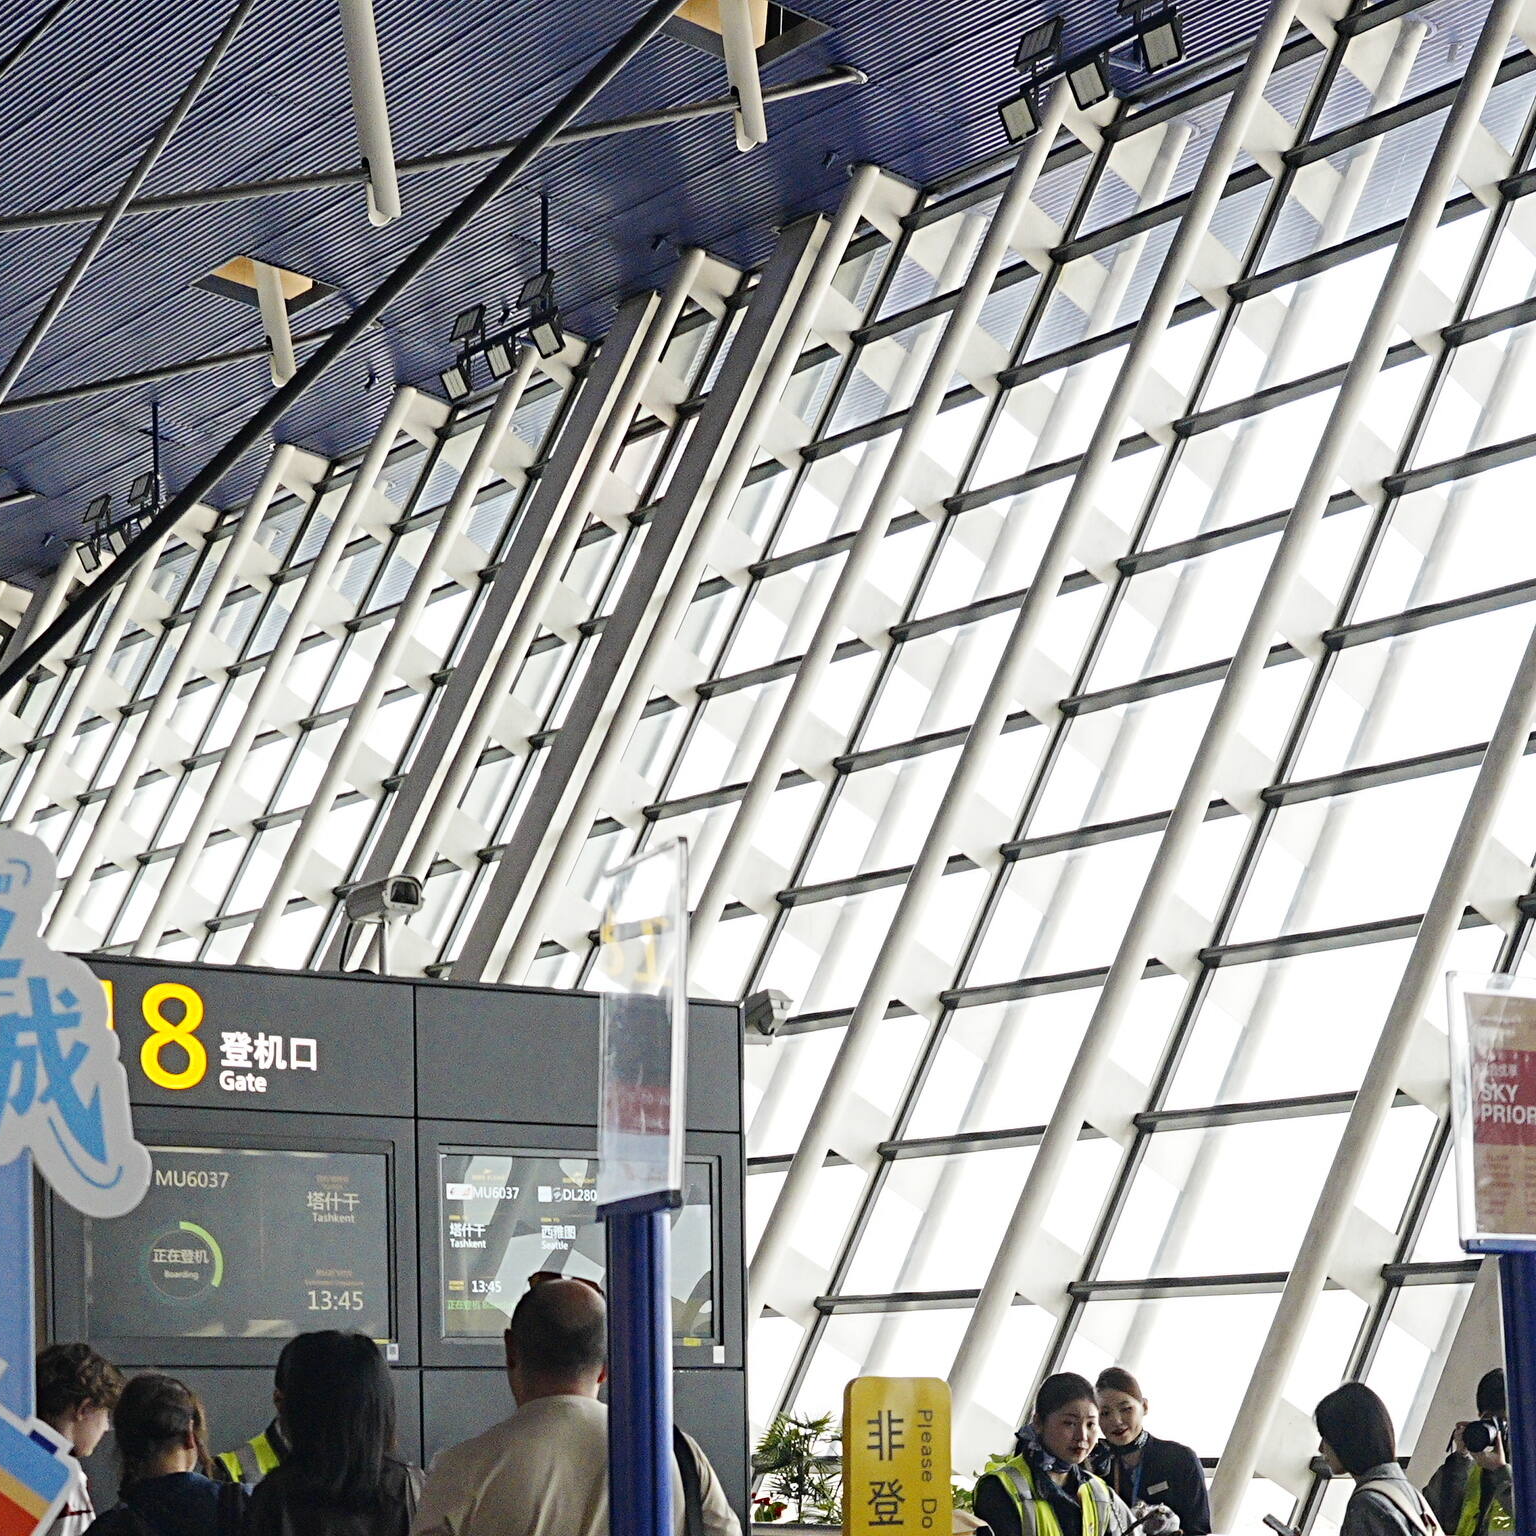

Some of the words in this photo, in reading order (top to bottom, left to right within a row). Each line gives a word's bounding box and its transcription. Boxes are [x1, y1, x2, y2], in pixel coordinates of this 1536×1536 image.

[219, 1031, 318, 1072] 登机口
[219, 1069, 268, 1093] Gate
[1481, 1083, 1520, 1104] SKY
[154, 1169, 231, 1189] MU6037
[306, 1191, 361, 1212] 塔什干
[471, 1186, 520, 1200] MU6037
[312, 1212, 356, 1224] Tashkent
[449, 1223, 487, 1238] 塔什干
[540, 1225, 576, 1239] 西雅图
[449, 1237, 487, 1249] Tashkent
[540, 1239, 569, 1250] Seattle
[151, 1248, 210, 1264] 正在登机
[471, 1280, 502, 1293] 13:45
[308, 1290, 364, 1311] 13:45
[917, 1409, 934, 1483] Please
[920, 1498, 938, 1529] Do
